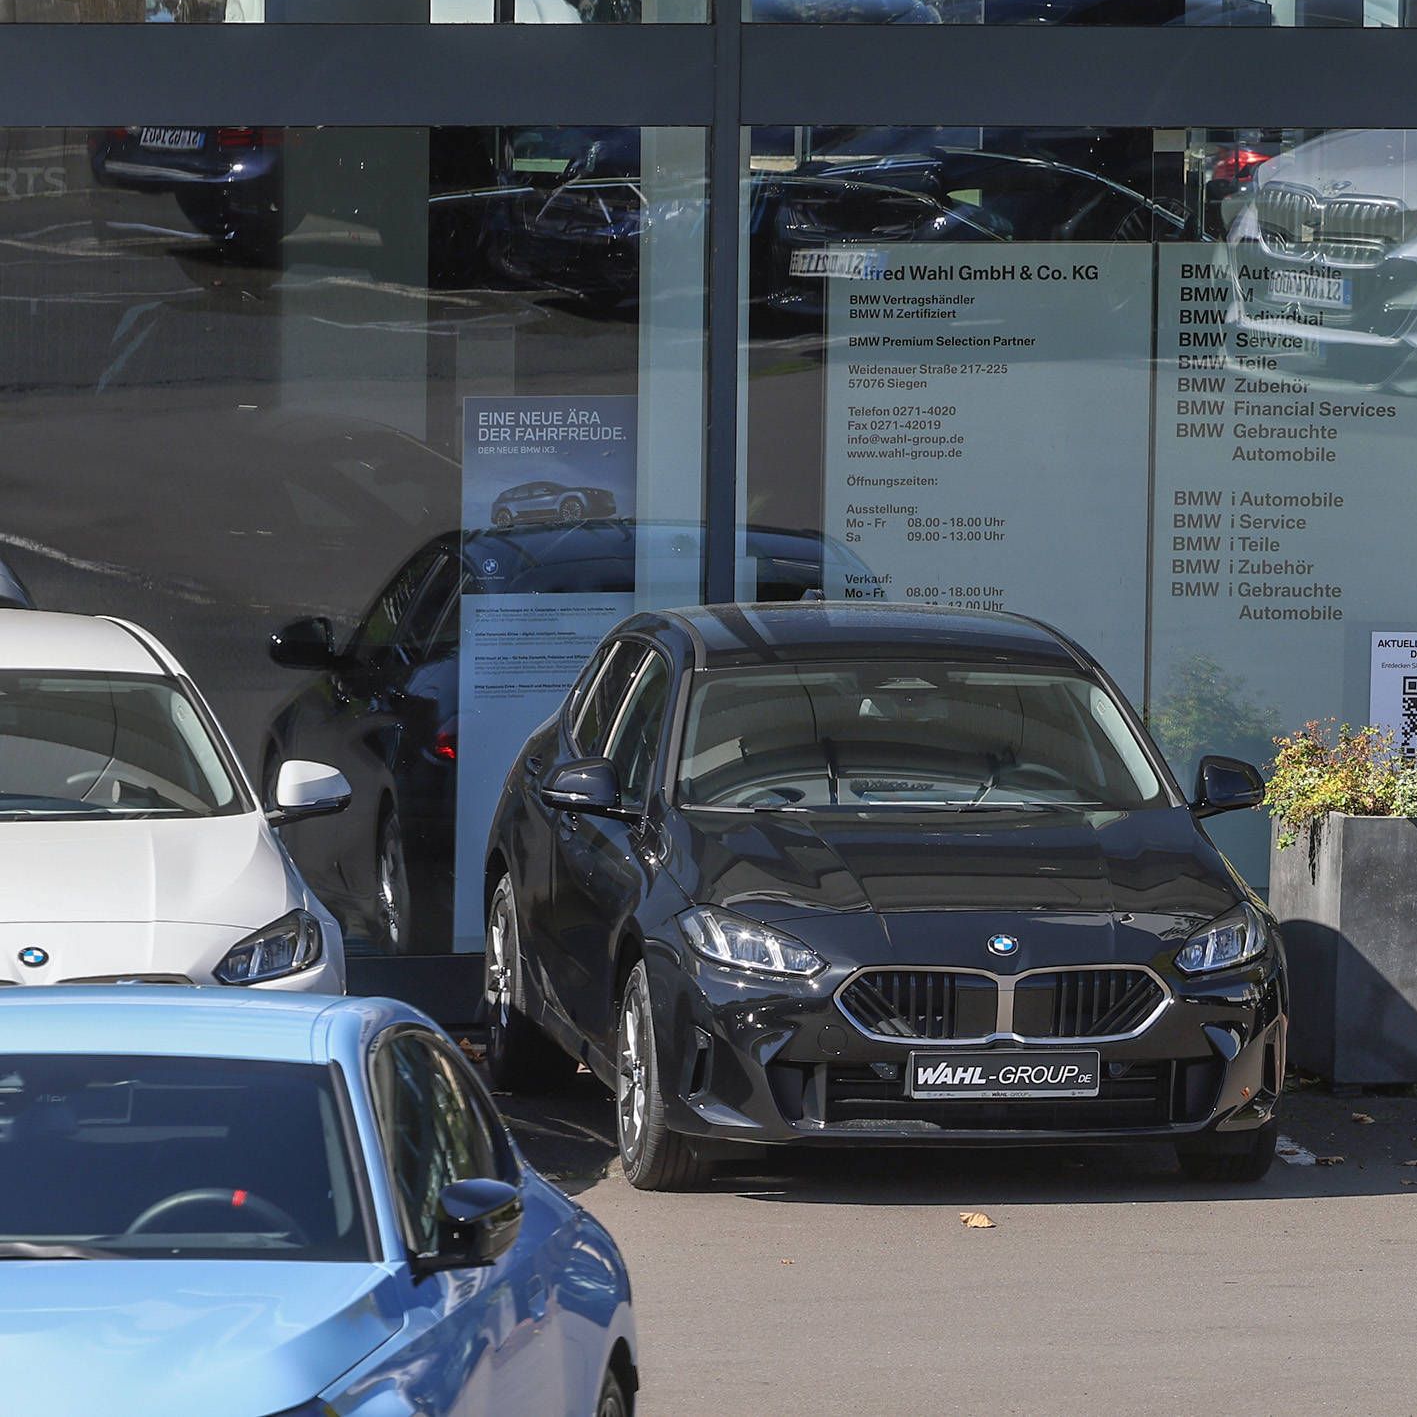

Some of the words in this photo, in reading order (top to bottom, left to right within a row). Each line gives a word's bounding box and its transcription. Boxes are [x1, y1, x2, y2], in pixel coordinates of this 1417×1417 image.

[850, 265, 905, 281] lfred
[910, 265, 954, 281] Wahl
[958, 265, 1014, 281] GmbH
[1021, 266, 1033, 280] &
[1037, 266, 1067, 280] Co.
[1073, 265, 1098, 280] KG
[1181, 265, 1229, 279] BMW
[850, 295, 880, 305] BMW
[883, 294, 975, 307] Vertragshändler
[1180, 287, 1229, 302] BMW
[849, 309, 880, 319] BMW
[883, 309, 894, 319] M
[897, 308, 957, 319] Zertifiziert
[1179, 310, 1228, 324] BMW
[849, 337, 879, 346] BMW
[883, 337, 933, 346] Premium
[936, 337, 990, 346] Selection
[993, 337, 1035, 346] Partner
[1179, 333, 1227, 347] BMW
[1236, 333, 1303, 348] Service
[848, 364, 916, 375] Weidenauer
[919, 364, 957, 375] Straße
[960, 365, 1008, 374] 217-225
[1178, 356, 1227, 370] BMW
[1235, 356, 1277, 371] Teile
[848, 379, 884, 388] 57076
[887, 379, 927, 391] Siegen
[1177, 378, 1226, 393] BMW
[1234, 378, 1310, 394] Zubehör
[848, 406, 890, 416] Telefon
[893, 407, 956, 416] 0271-4020
[1176, 401, 1225, 415] BMW
[1234, 401, 1315, 416] Financial
[1319, 402, 1396, 417] Services
[479, 412, 515, 425] EINE
[520, 412, 562, 425] NEUE
[567, 409, 600, 424] ÄRA
[848, 421, 868, 430] Fax
[870, 421, 941, 430] 0271-42019
[1176, 423, 1224, 438] BMW
[1233, 423, 1337, 439] Gebrauchte
[479, 428, 510, 441] DER
[516, 427, 626, 441] FAHRFREUDE.
[847, 434, 964, 447] info@wahl-group.de
[847, 448, 962, 461] www.wahl-group.de
[1232, 446, 1336, 462] Automobile
[847, 475, 938, 488] Öffnungszeiten:
[1174, 491, 1222, 506] BMW
[1231, 492, 1235, 506] i
[1240, 491, 1344, 507] Automobile
[846, 504, 918, 516] Ausstellung:
[846, 519, 865, 528] Mo
[875, 519, 886, 528] Fr
[907, 518, 940, 527] 08.00
[950, 518, 981, 527] 18.00
[984, 517, 1005, 527] Uhr
[1173, 514, 1221, 528] BMW
[1231, 514, 1235, 529] i
[1239, 515, 1306, 529] Service
[846, 533, 861, 542] Sa
[907, 532, 940, 542] 09.00
[950, 532, 981, 541] 13.00
[984, 531, 1005, 541] Uhr
[1172, 537, 1220, 551] BMW
[1230, 537, 1234, 551] i
[1239, 537, 1280, 552] Teile
[1172, 560, 1220, 574] BMW
[1229, 560, 1233, 574] i
[1238, 559, 1313, 575] Zubehör
[845, 574, 892, 584] Verkauf:
[845, 589, 862, 598] Mo
[873, 588, 885, 597] Fr
[907, 588, 938, 597] 08.00
[949, 587, 980, 596] 18.00
[983, 587, 1004, 596] Uhr
[1171, 582, 1219, 597] BMW
[1228, 583, 1233, 597] i
[1238, 582, 1342, 598] Gebrauchte
[1239, 605, 1343, 621] Automobile
